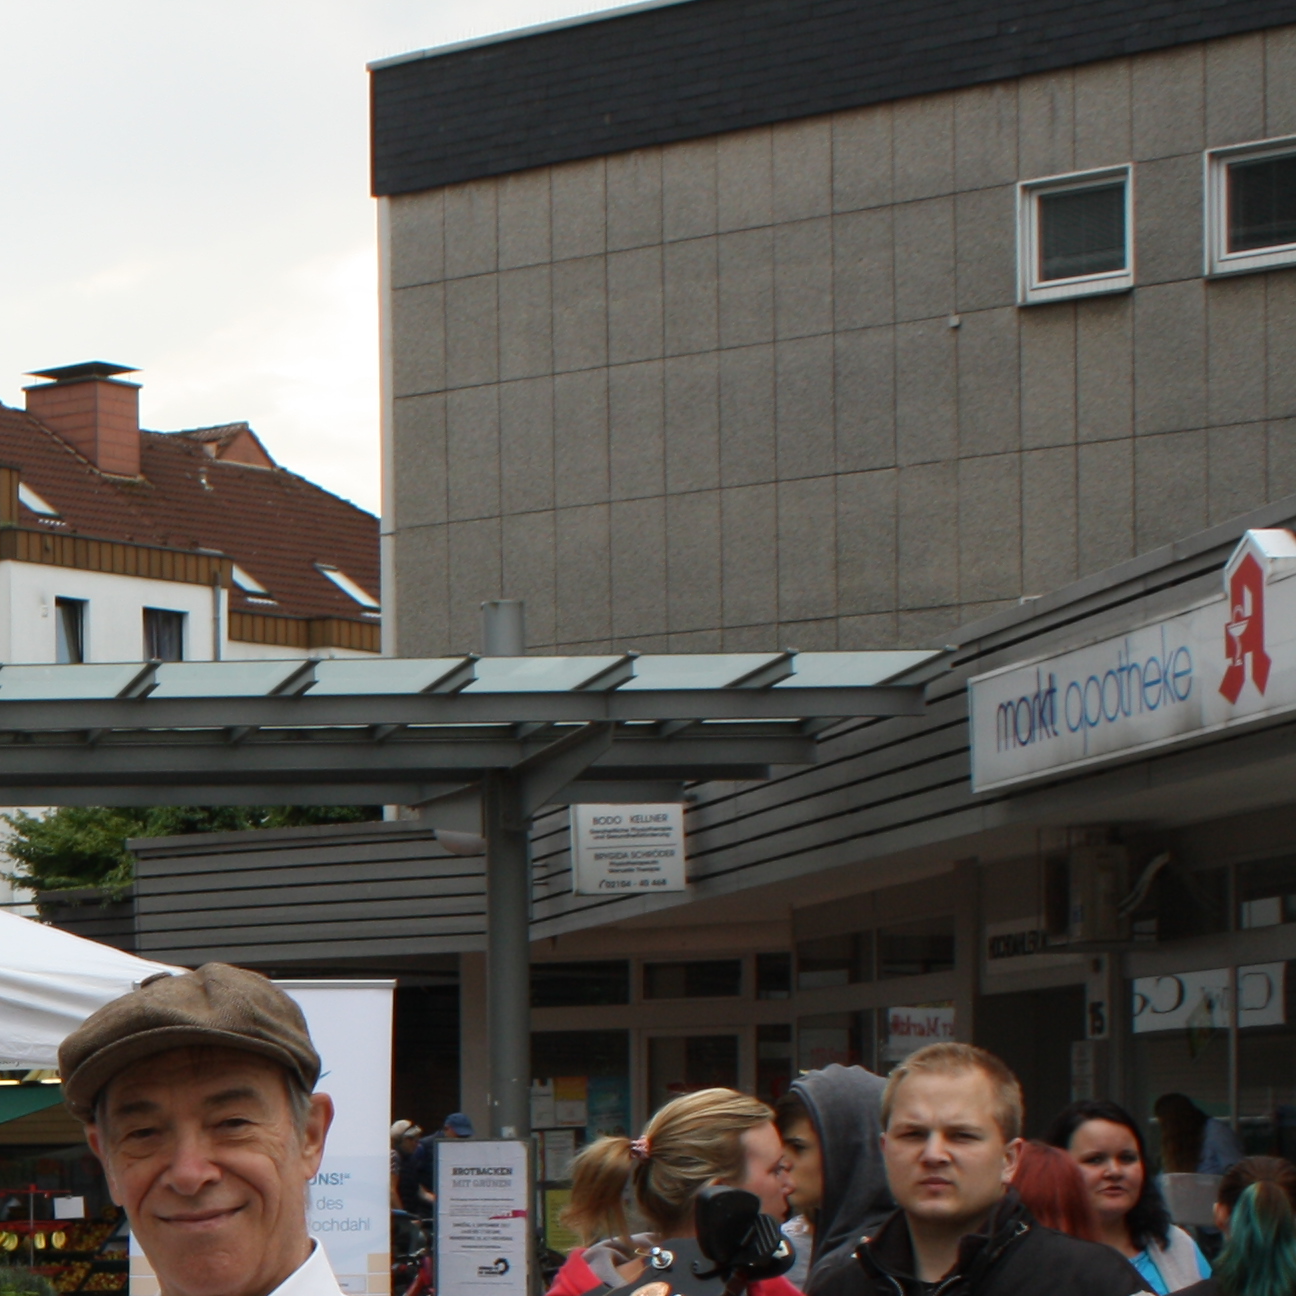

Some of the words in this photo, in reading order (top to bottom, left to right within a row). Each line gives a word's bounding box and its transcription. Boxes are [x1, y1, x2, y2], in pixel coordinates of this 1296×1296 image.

[997, 667, 1060, 753] markt
[1064, 624, 1193, 756] apotheke
[592, 815, 622, 826] BODO
[629, 813, 669, 824] KELLNER
[316, 1197, 344, 1211] des
[311, 1218, 371, 1232] ochdahl
